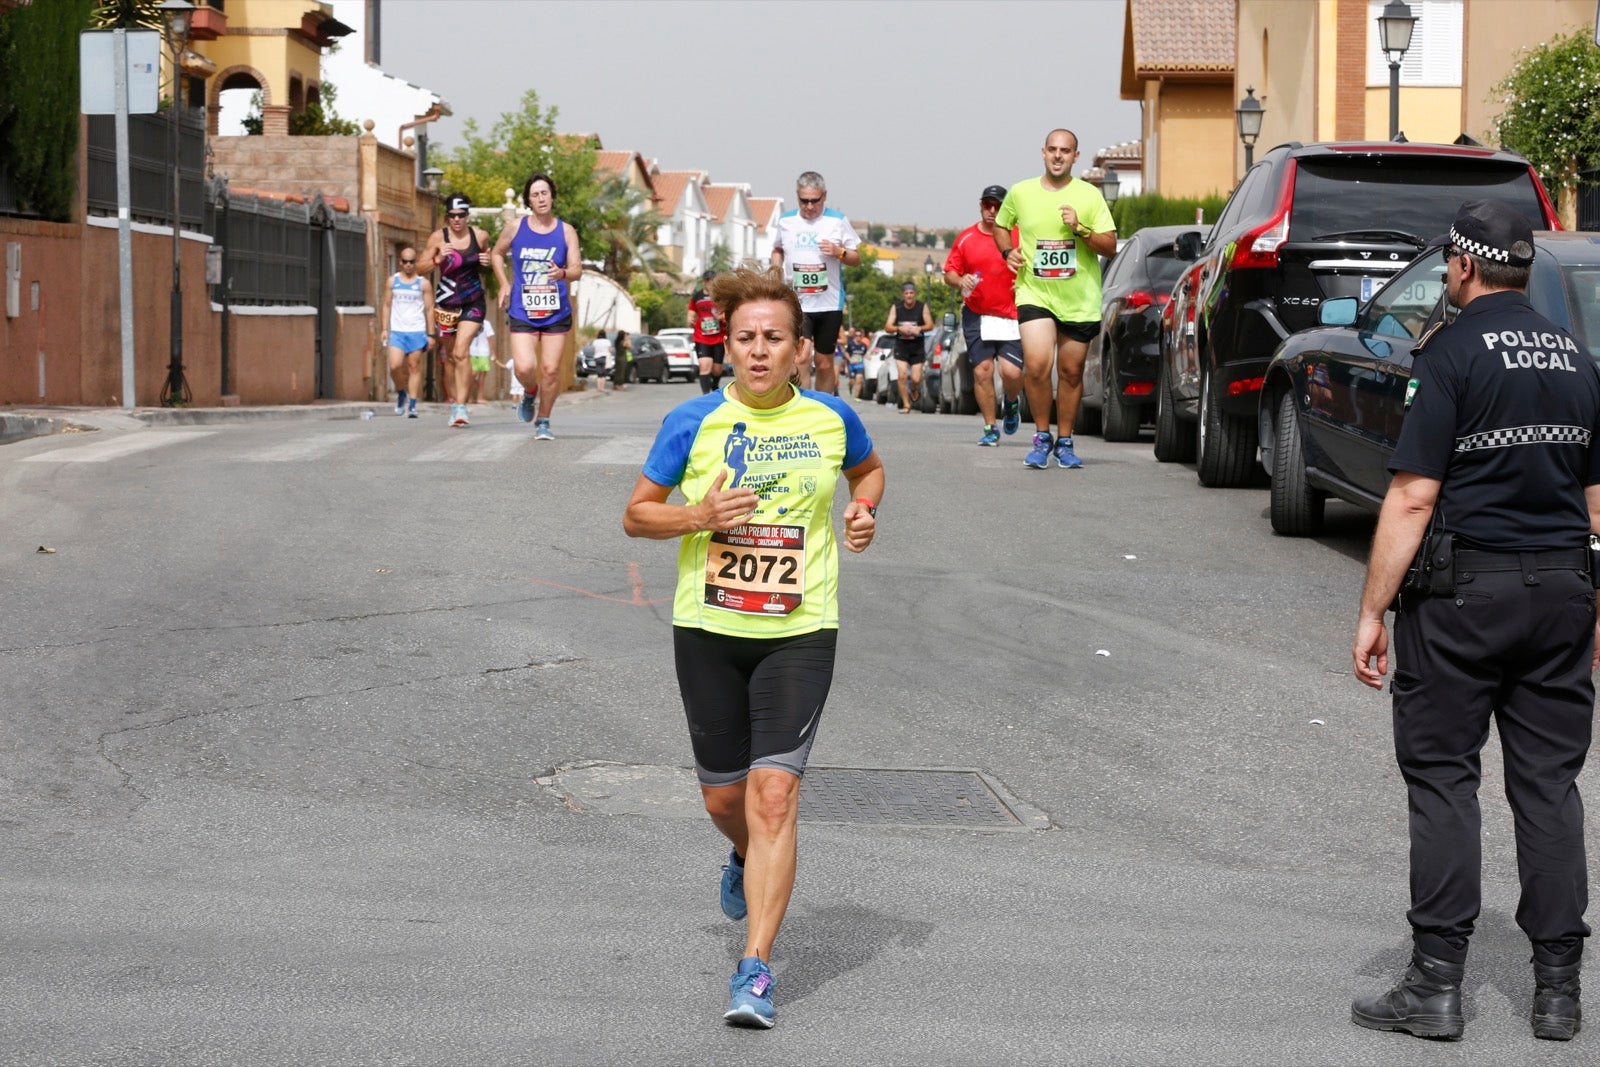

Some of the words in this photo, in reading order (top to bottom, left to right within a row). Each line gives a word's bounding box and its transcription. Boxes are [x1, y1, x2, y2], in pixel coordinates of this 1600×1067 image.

[1041, 251, 1069, 265] 360
[802, 274, 818, 284] 89
[526, 295, 556, 306] 3018
[1482, 331, 1579, 354] POLICIA
[1502, 350, 1576, 372] LOCAL
[761, 433, 810, 443] CARRERA
[758, 442, 819, 452] SOLIDARIA
[747, 452, 773, 462] LUX
[777, 450, 822, 461] MUNDI
[741, 480, 778, 489] CONTRA
[730, 525, 746, 536] GRAN
[748, 526, 770, 538] PREMIO
[771, 528, 779, 538] DE
[780, 527, 800, 539] FONDO
[718, 551, 798, 584] 2072
